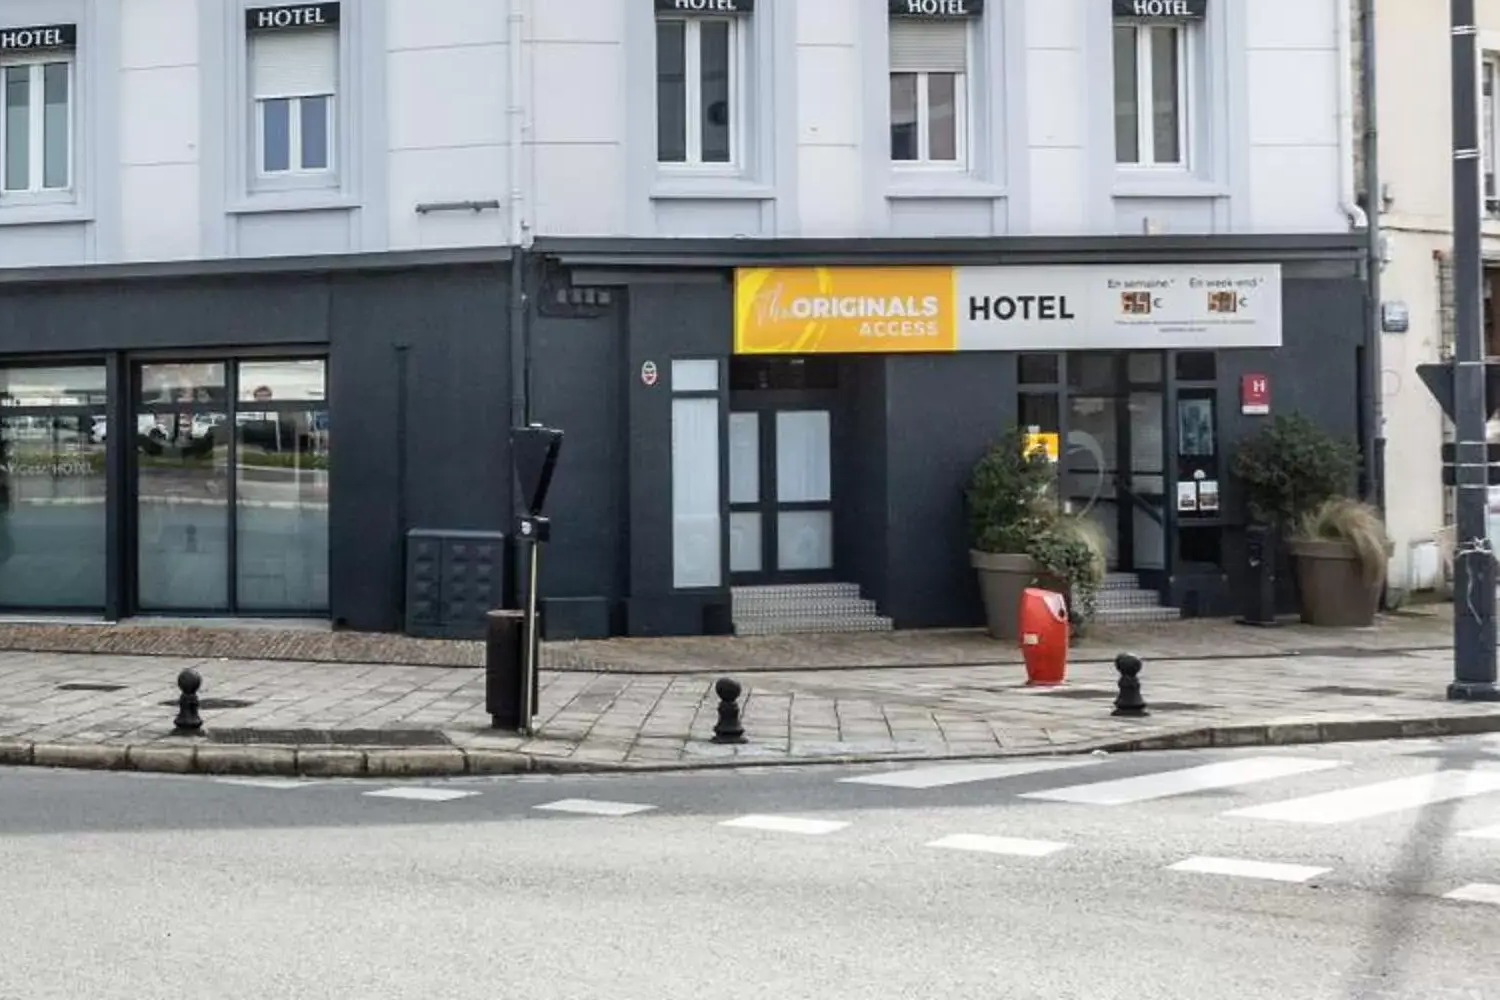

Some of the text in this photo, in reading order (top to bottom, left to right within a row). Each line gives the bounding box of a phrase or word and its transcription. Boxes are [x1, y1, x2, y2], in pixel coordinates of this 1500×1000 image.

[258, 8, 325, 27] HOTEL
[1133, 0, 1193, 16] HOTEL
[2, 29, 63, 48] HOTEL
[792, 296, 939, 318] ORIGINALS
[969, 296, 1075, 321] HOTEL
[859, 321, 938, 337] ACCESS
